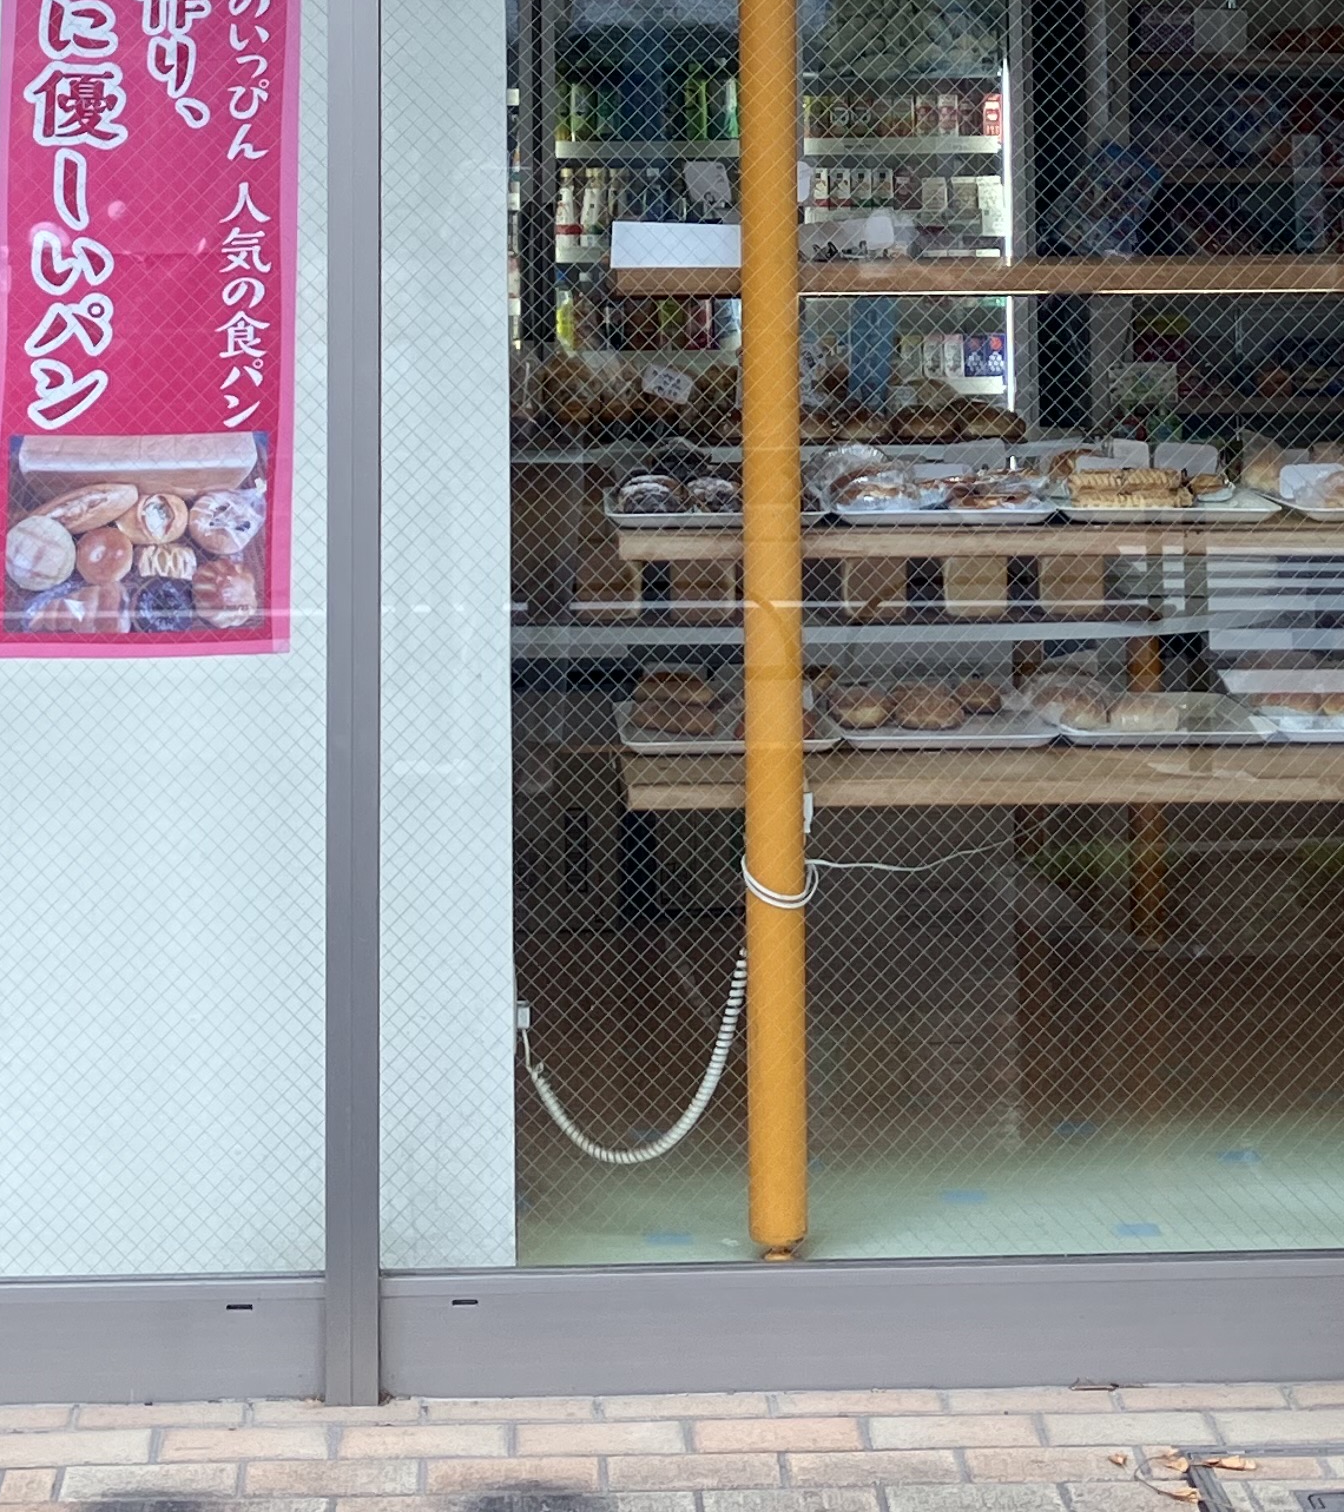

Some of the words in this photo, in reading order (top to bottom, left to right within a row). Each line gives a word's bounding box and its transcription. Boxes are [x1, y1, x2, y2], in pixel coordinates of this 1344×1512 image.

[215, 181, 272, 428] 人気の食パン
